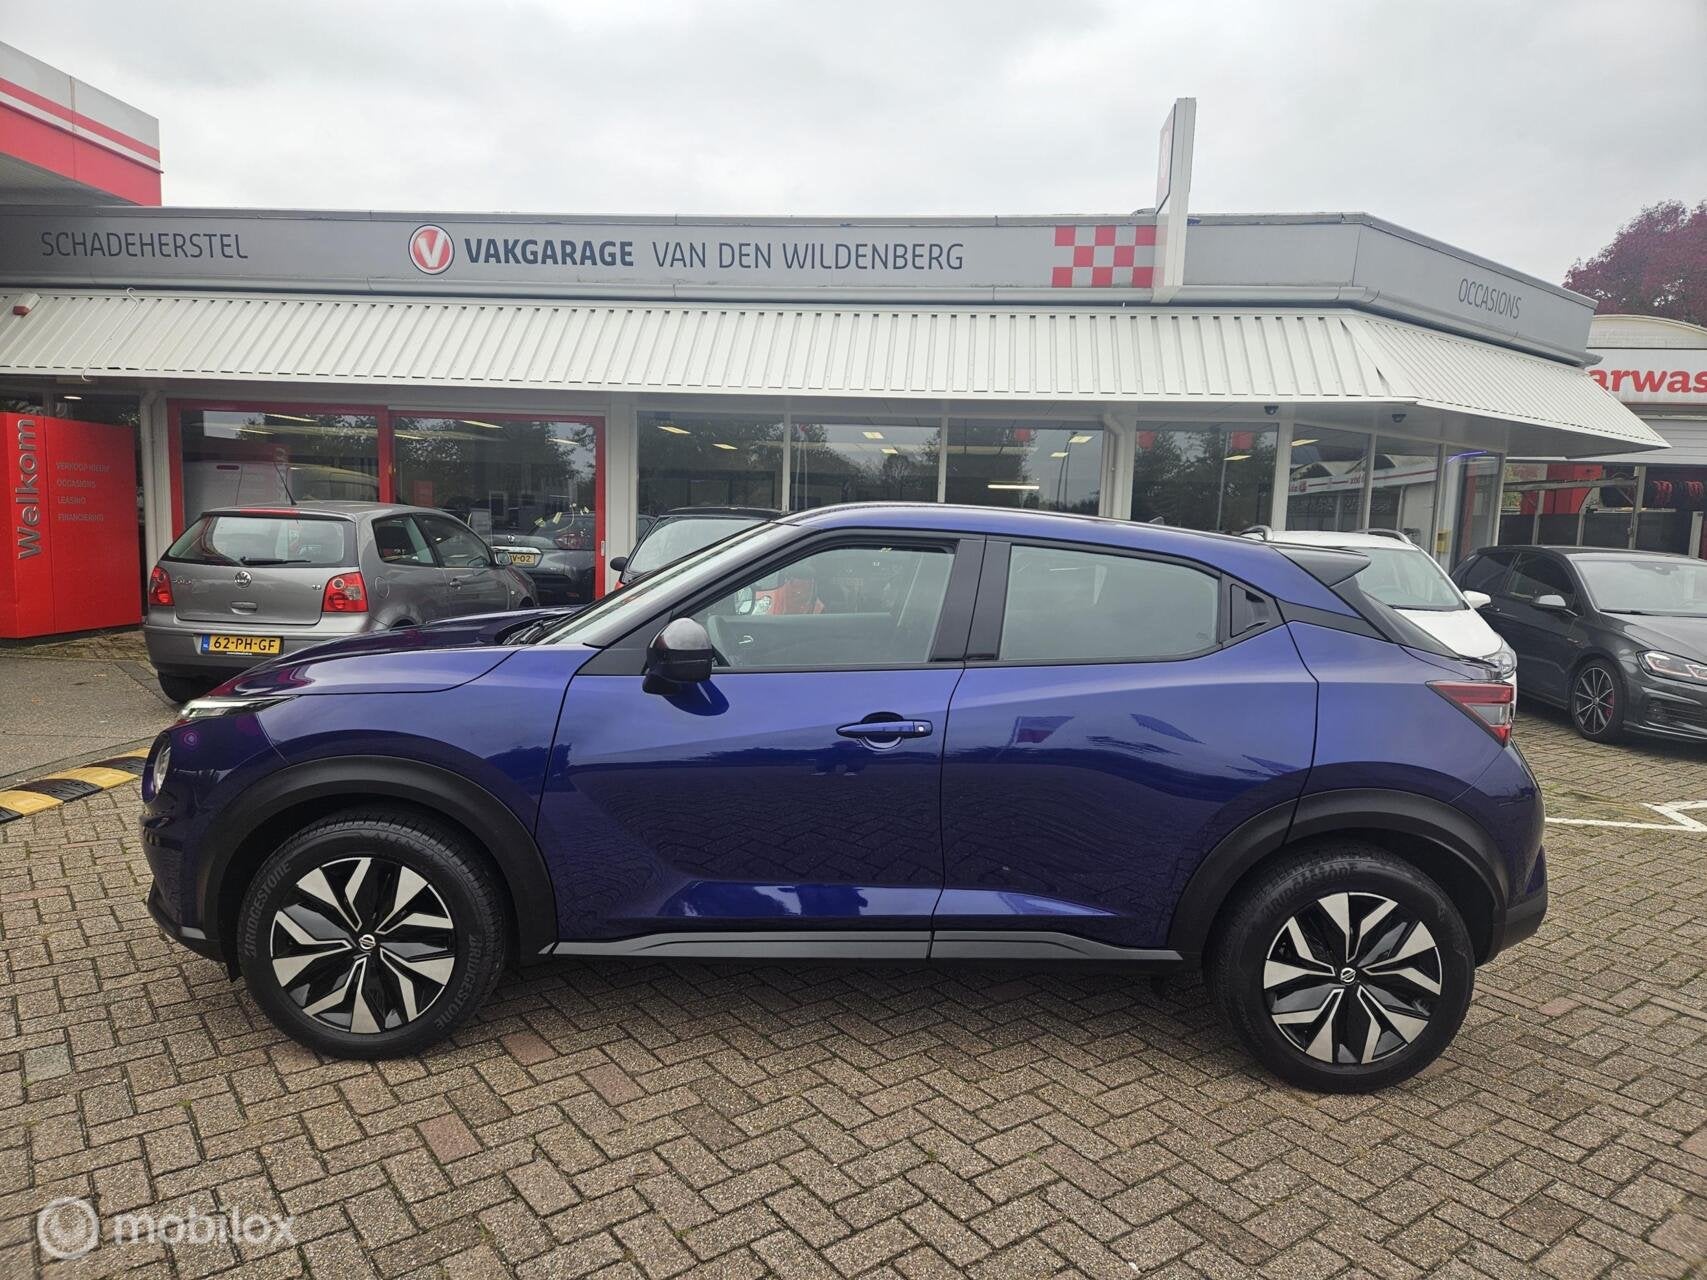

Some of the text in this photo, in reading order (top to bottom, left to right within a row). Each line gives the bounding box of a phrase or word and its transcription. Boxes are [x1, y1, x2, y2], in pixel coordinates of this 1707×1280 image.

[41, 231, 248, 259] SCHADEHERSTEL
[464, 237, 634, 267] VAKGARAGE
[652, 240, 706, 268] VAN
[718, 242, 772, 269] DEN
[782, 243, 964, 270] WILDENBERG
[1458, 278, 1522, 319] OCCASIONS
[16, 418, 42, 560] Welkom
[213, 637, 276, 651] 62-PH-GF
